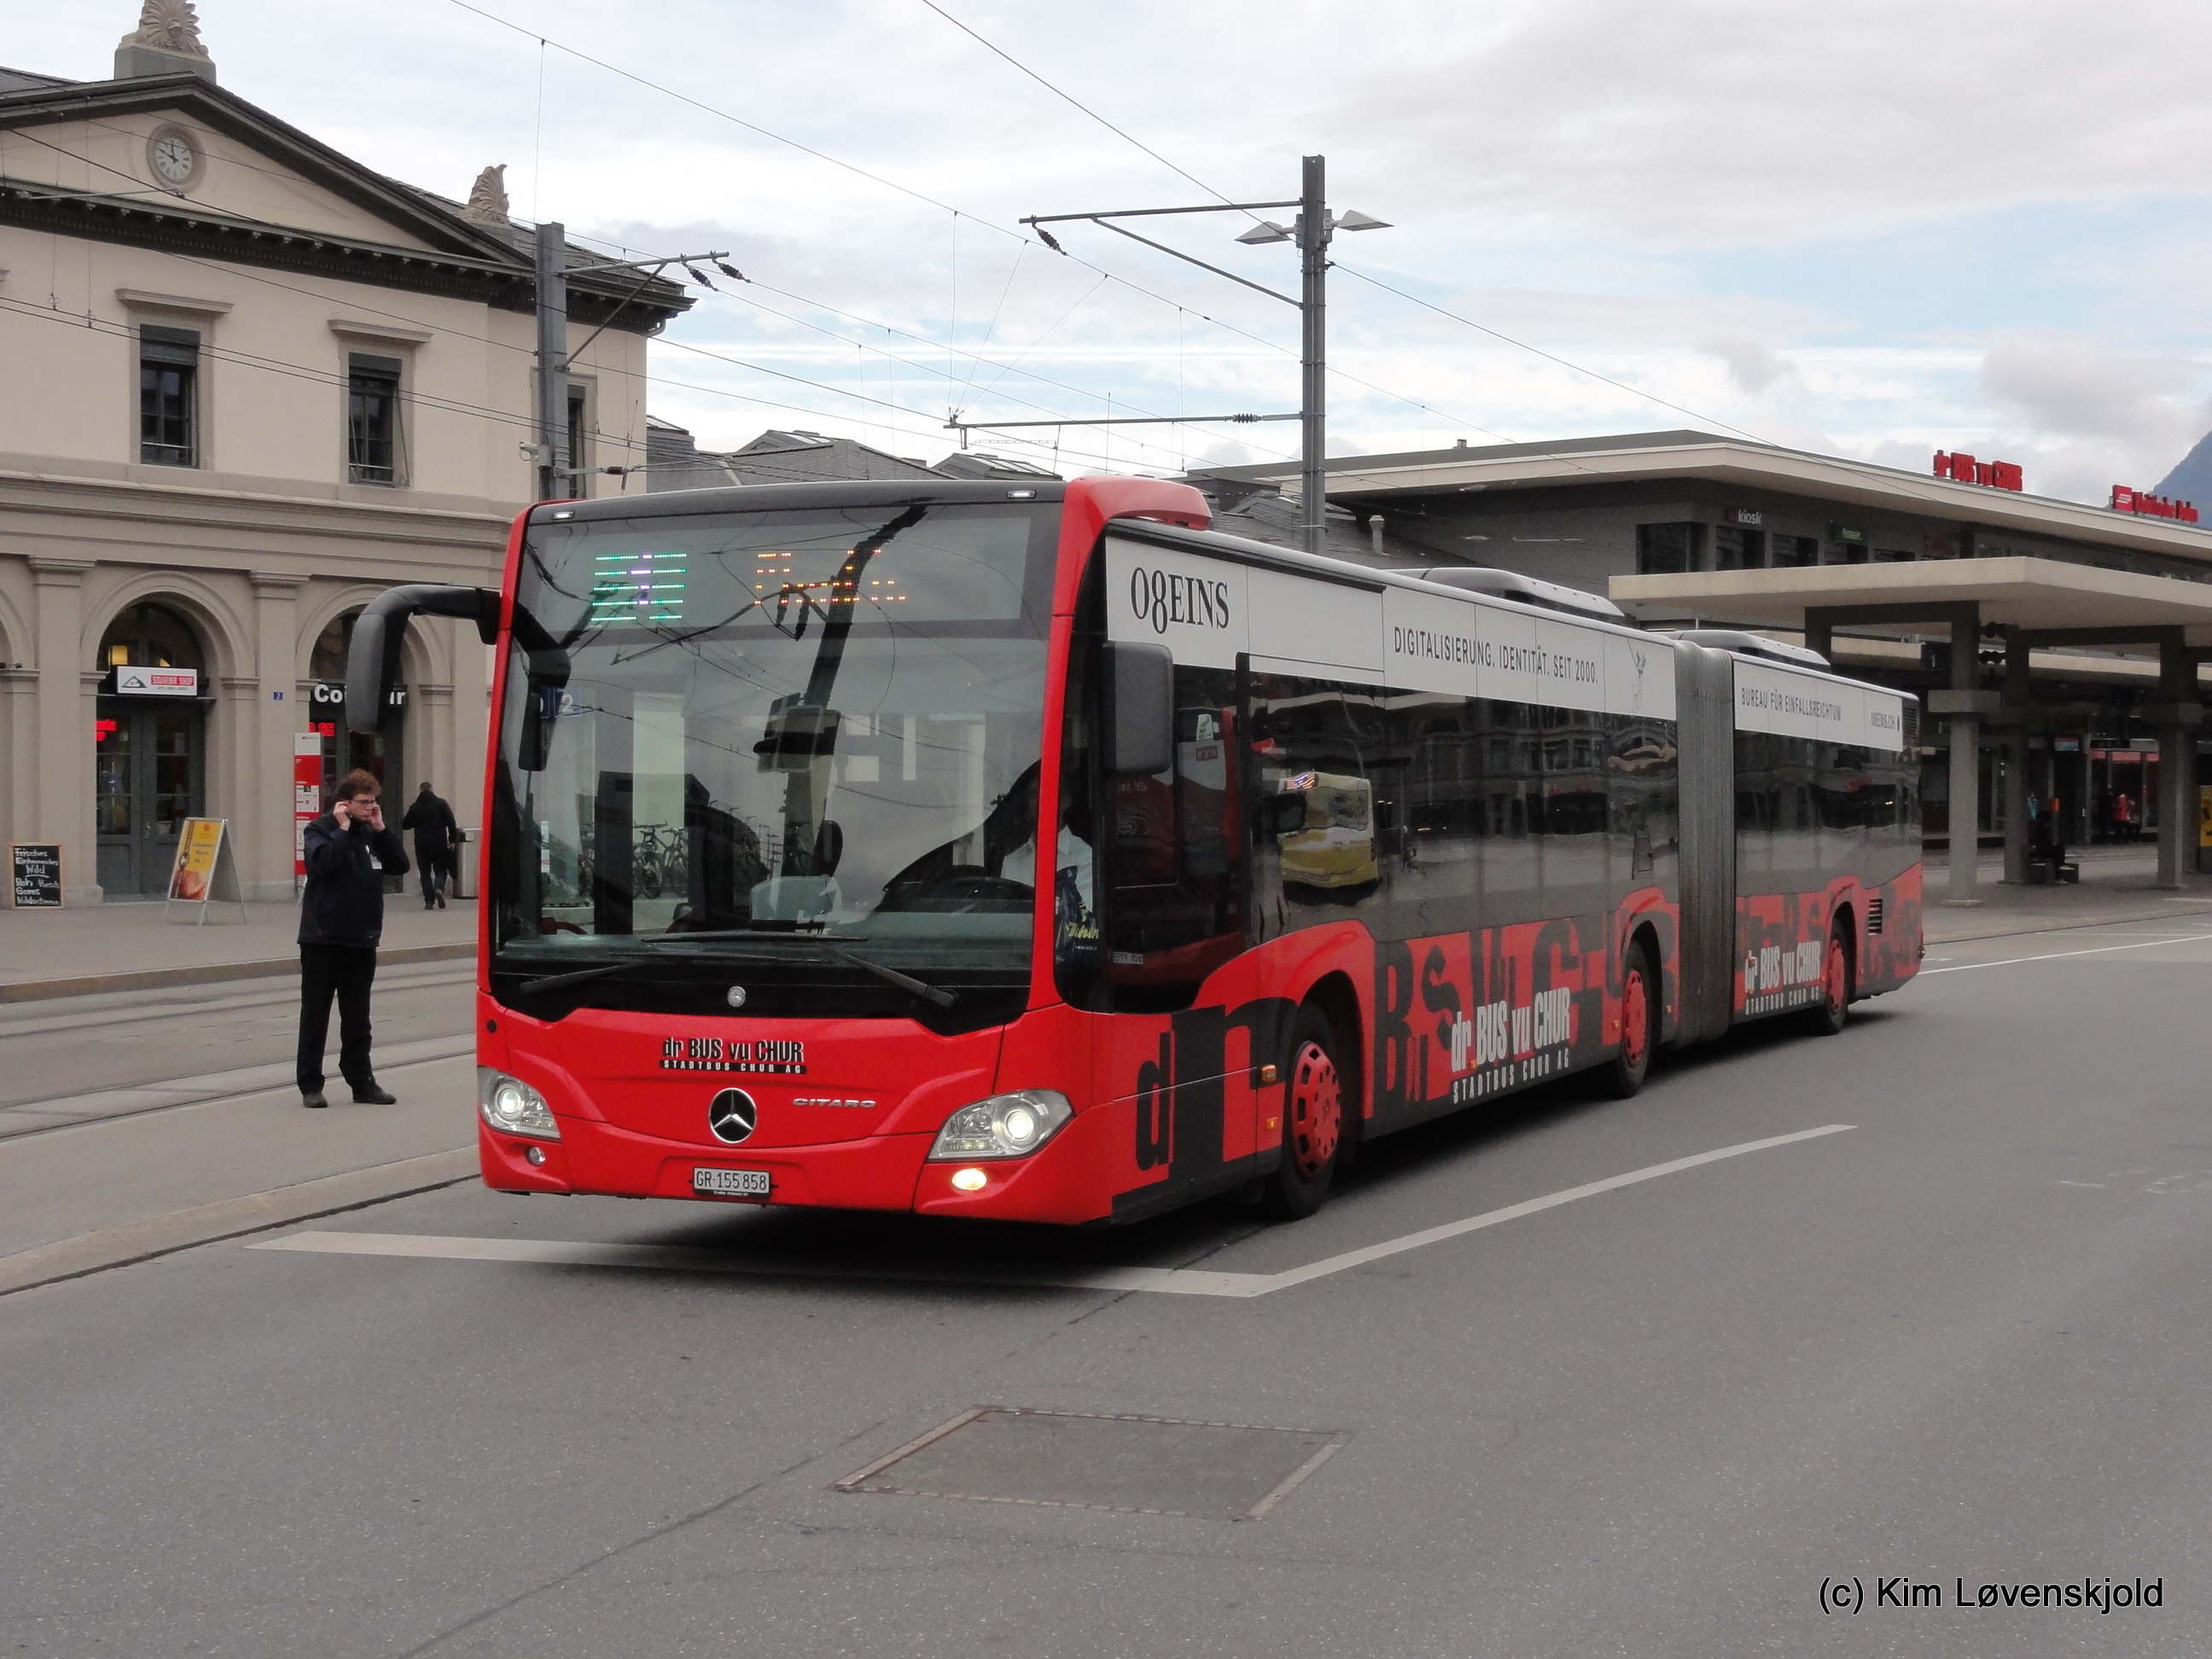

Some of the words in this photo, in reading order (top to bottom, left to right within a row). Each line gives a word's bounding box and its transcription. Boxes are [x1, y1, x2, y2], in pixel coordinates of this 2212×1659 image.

[1738, 509, 1762, 525] kiosk
[1394, 626, 1495, 667] DIGITALISIERUNG.
[1499, 645, 1550, 677] IDENTITÄT.
[1553, 655, 1572, 680] SEIT
[1575, 659, 1598, 684] 2000.
[153, 676, 177, 684] SOUVENIR
[179, 677, 193, 685] SHOP
[1741, 687, 1768, 709] BUREAU
[1770, 689, 1783, 711] FÜR
[26, 864, 45, 874] Wild
[1761, 946, 1780, 990] BUS
[1796, 940, 1820, 983] CHUR
[1451, 1010, 1472, 1073] dr
[1476, 1000, 1508, 1065] BUS
[1511, 1006, 1531, 1056] vu
[1534, 987, 1570, 1050] CHUR
[663, 1037, 684, 1057] dr
[689, 1038, 723, 1059] BUS
[729, 1041, 751, 1062] vu
[755, 1039, 805, 1062] CHUR
[664, 1059, 730, 1071] STADTBUS
[741, 1063, 775, 1074] CHUR
[785, 1065, 800, 1074] AG
[1453, 1064, 1515, 1104] STADTBUS
[1522, 1056, 1550, 1082] CHUR
[1557, 1047, 1569, 1069] AG
[792, 1097, 877, 1108] CITARO
